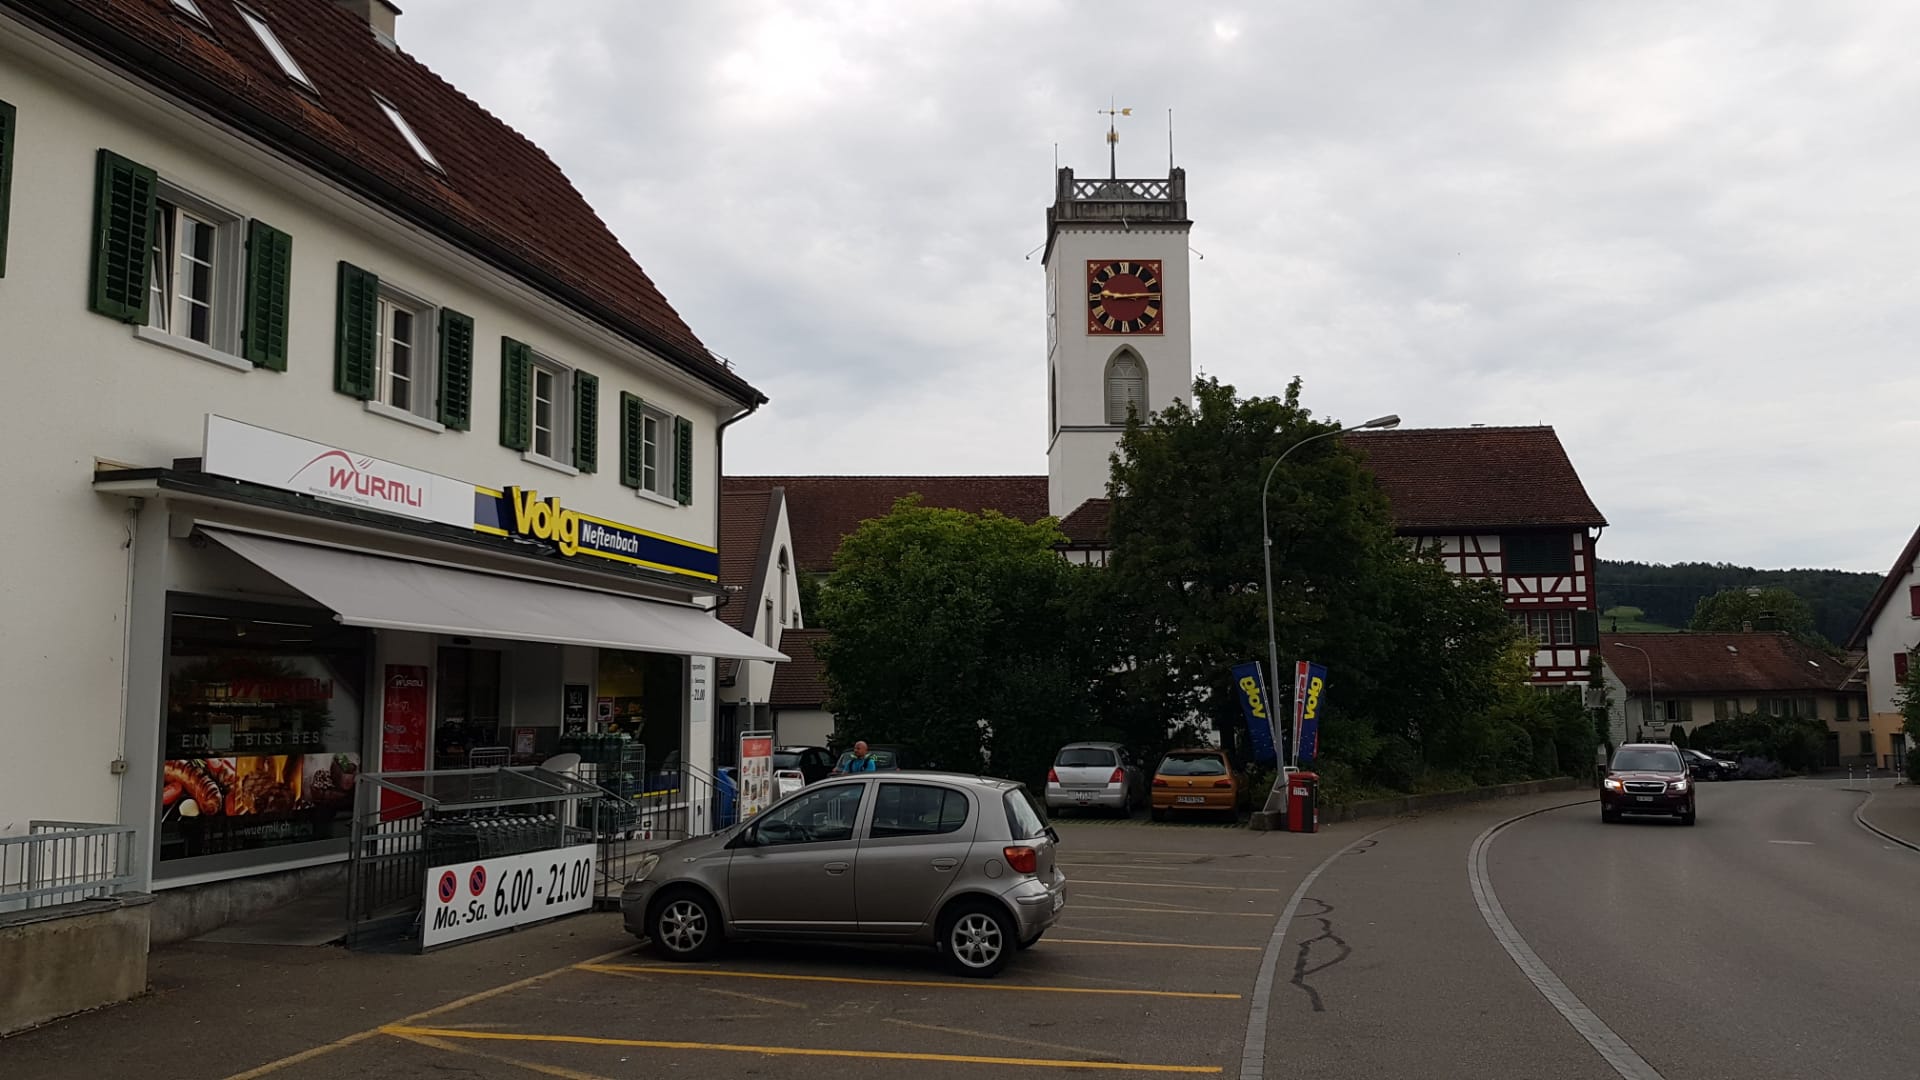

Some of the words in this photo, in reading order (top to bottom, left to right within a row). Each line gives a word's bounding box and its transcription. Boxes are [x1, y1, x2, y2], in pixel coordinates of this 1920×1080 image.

[511, 485, 579, 557] Volg
[581, 523, 639, 554] Neftenbach
[244, 731, 284, 746] BISS
[432, 899, 488, 931] Mo.-Sa.
[493, 867, 534, 918] 6.00
[545, 857, 591, 906] 21.00
